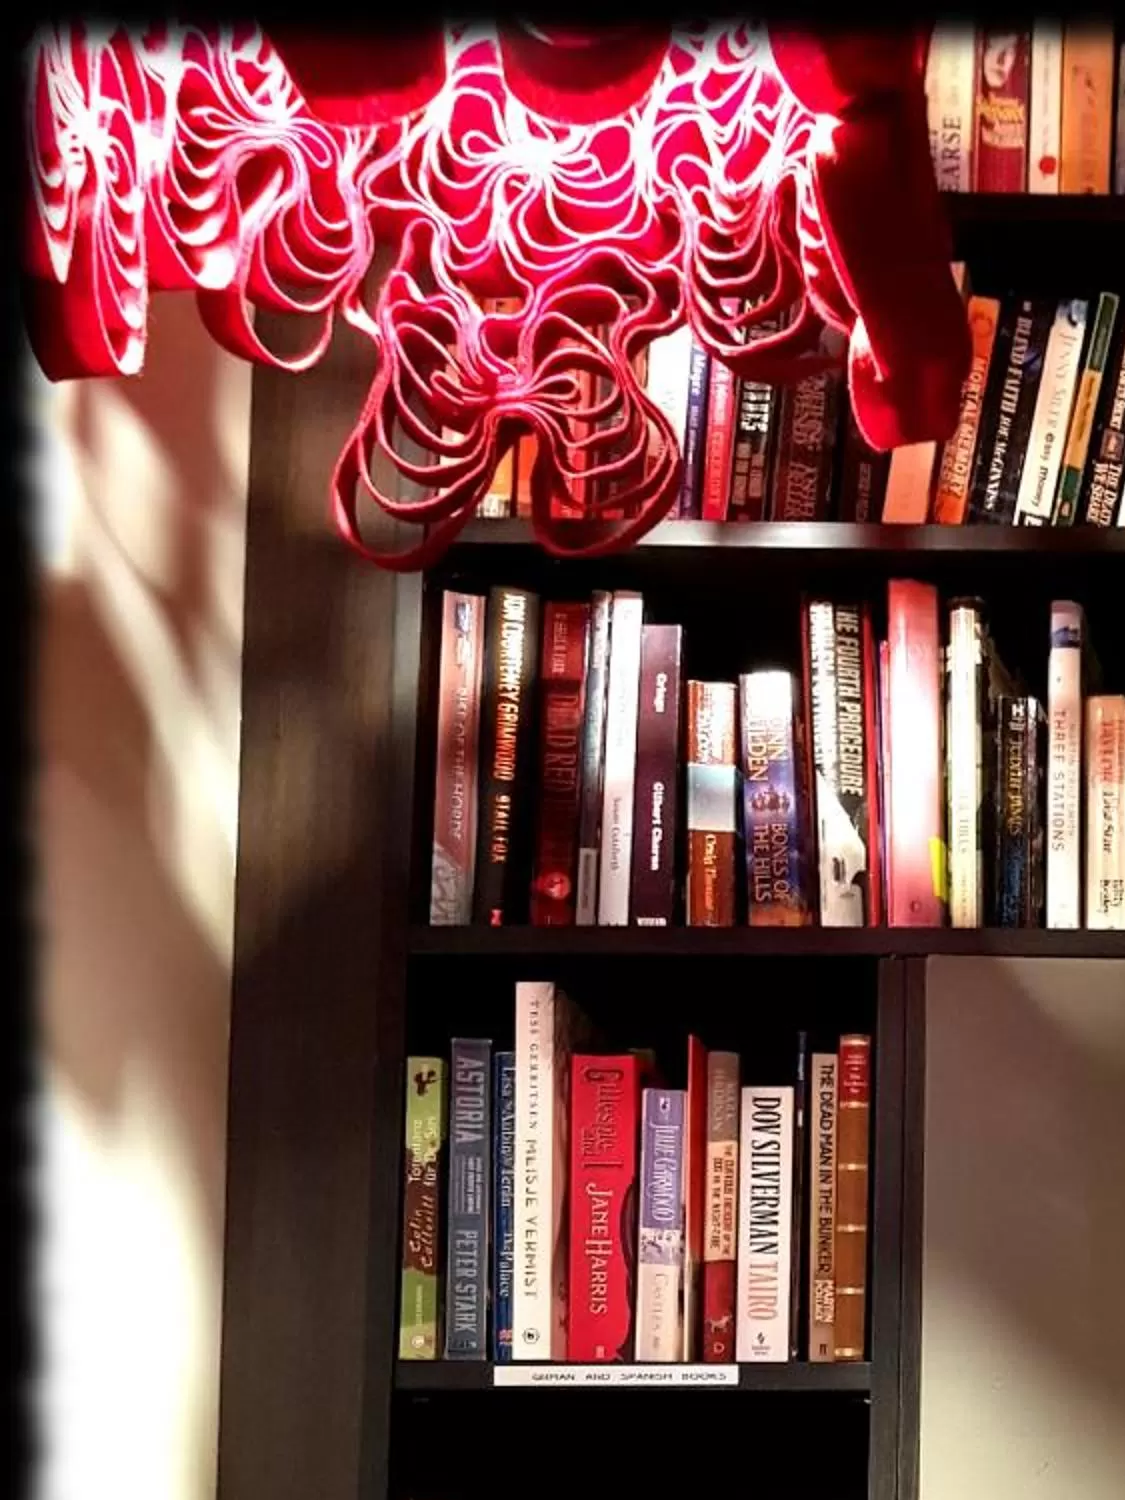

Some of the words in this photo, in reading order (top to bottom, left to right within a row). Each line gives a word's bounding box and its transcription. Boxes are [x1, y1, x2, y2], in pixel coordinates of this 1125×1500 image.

[1009, 316, 1033, 366] BLIND
[960, 356, 987, 421] MORTAL
[1001, 367, 1023, 415] FAITH
[950, 423, 974, 497] MEMORY
[503, 594, 526, 622] JON
[497, 622, 525, 703] COURTENEY
[837, 636, 861, 697] FOURTH
[493, 703, 520, 780] GRIMWOOD
[839, 702, 864, 796] PROCEDURE
[1053, 710, 1066, 763] THREE
[448, 783, 465, 840] HORDE
[1052, 772, 1066, 851] STATIONS
[491, 836, 509, 864] FOX
[704, 834, 717, 865] Craig
[753, 824, 770, 854] THE
[771, 823, 789, 876] BONES
[1101, 823, 1115, 854] Star
[754, 859, 772, 902] HILLS
[773, 880, 792, 903] OF
[529, 999, 541, 1033] TESS
[454, 1055, 485, 1142] ASTORIA
[501, 1066, 515, 1097] Lisa
[528, 1044, 541, 1130] GERRITSEN
[819, 1064, 834, 1088] THE
[750, 1096, 782, 1135] DOV
[818, 1091, 834, 1130] DEAD
[650, 1123, 680, 1156] JULIE
[818, 1133, 834, 1165] MAN
[524, 1138, 539, 1207] MEISJE
[648, 1157, 680, 1221] GARWOOD
[748, 1139, 781, 1255] SILVERMAN
[818, 1169, 833, 1184] IN
[585, 1182, 614, 1236] JANE
[818, 1188, 833, 1213] THE
[455, 1229, 480, 1279] PETER
[524, 1216, 539, 1300] VERMIST
[817, 1217, 833, 1273] BUNKER
[499, 1249, 514, 1297] Palace
[585, 1239, 613, 1314] HARRIS
[746, 1261, 779, 1321] TAIRO
[454, 1283, 479, 1332] STARK
[823, 1279, 834, 1322] MARTIN
[585, 1372, 611, 1381] AND
[619, 1372, 673, 1382] SPANISH
[681, 1372, 727, 1381] BOOKS
